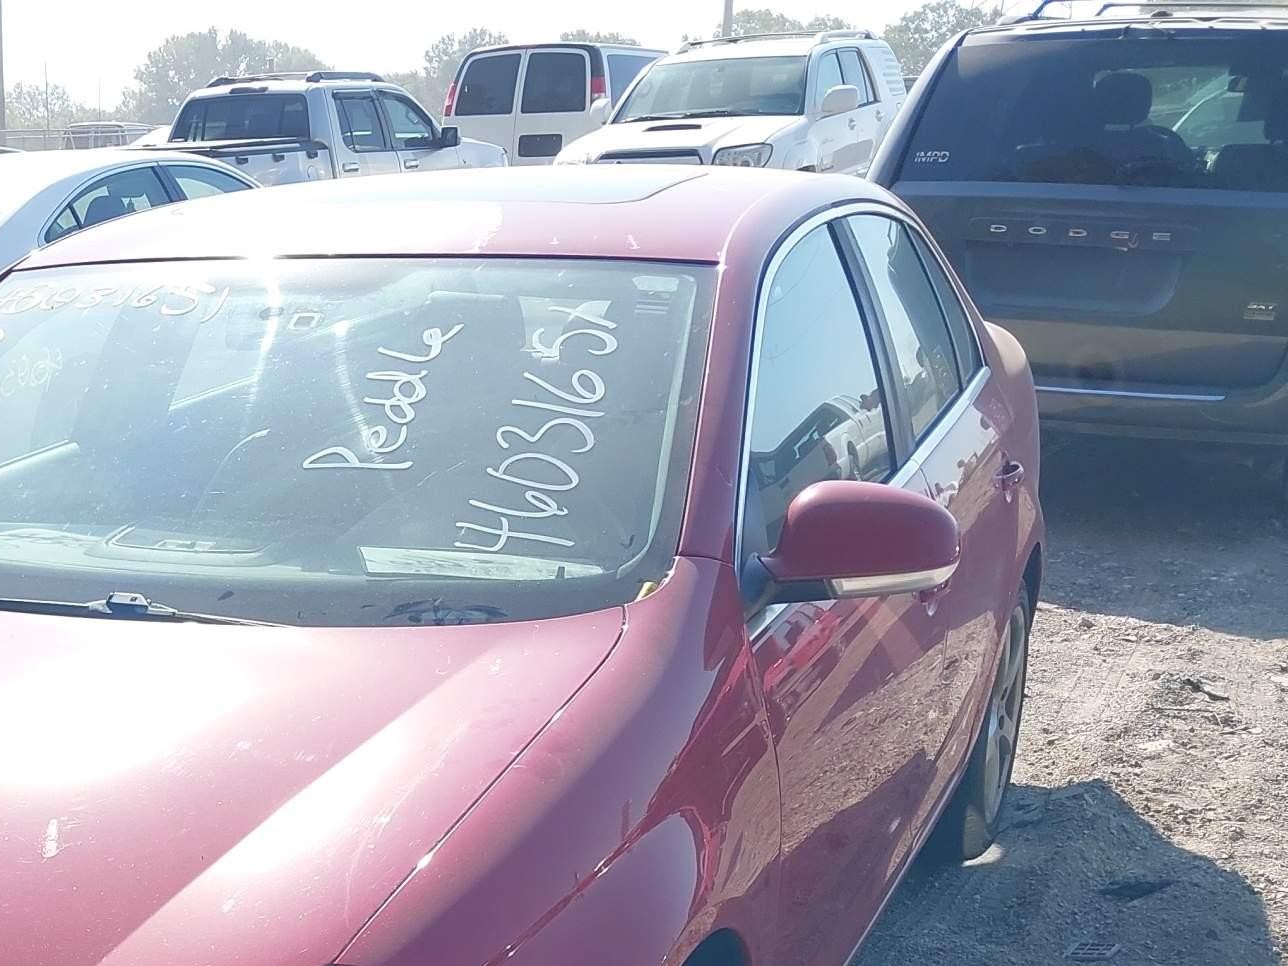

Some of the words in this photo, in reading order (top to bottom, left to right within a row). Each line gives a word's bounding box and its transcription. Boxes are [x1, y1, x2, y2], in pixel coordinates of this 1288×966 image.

[914, 151, 950, 163] IMPD
[989, 223, 1172, 242] DODGE
[302, 323, 464, 469] Peddle
